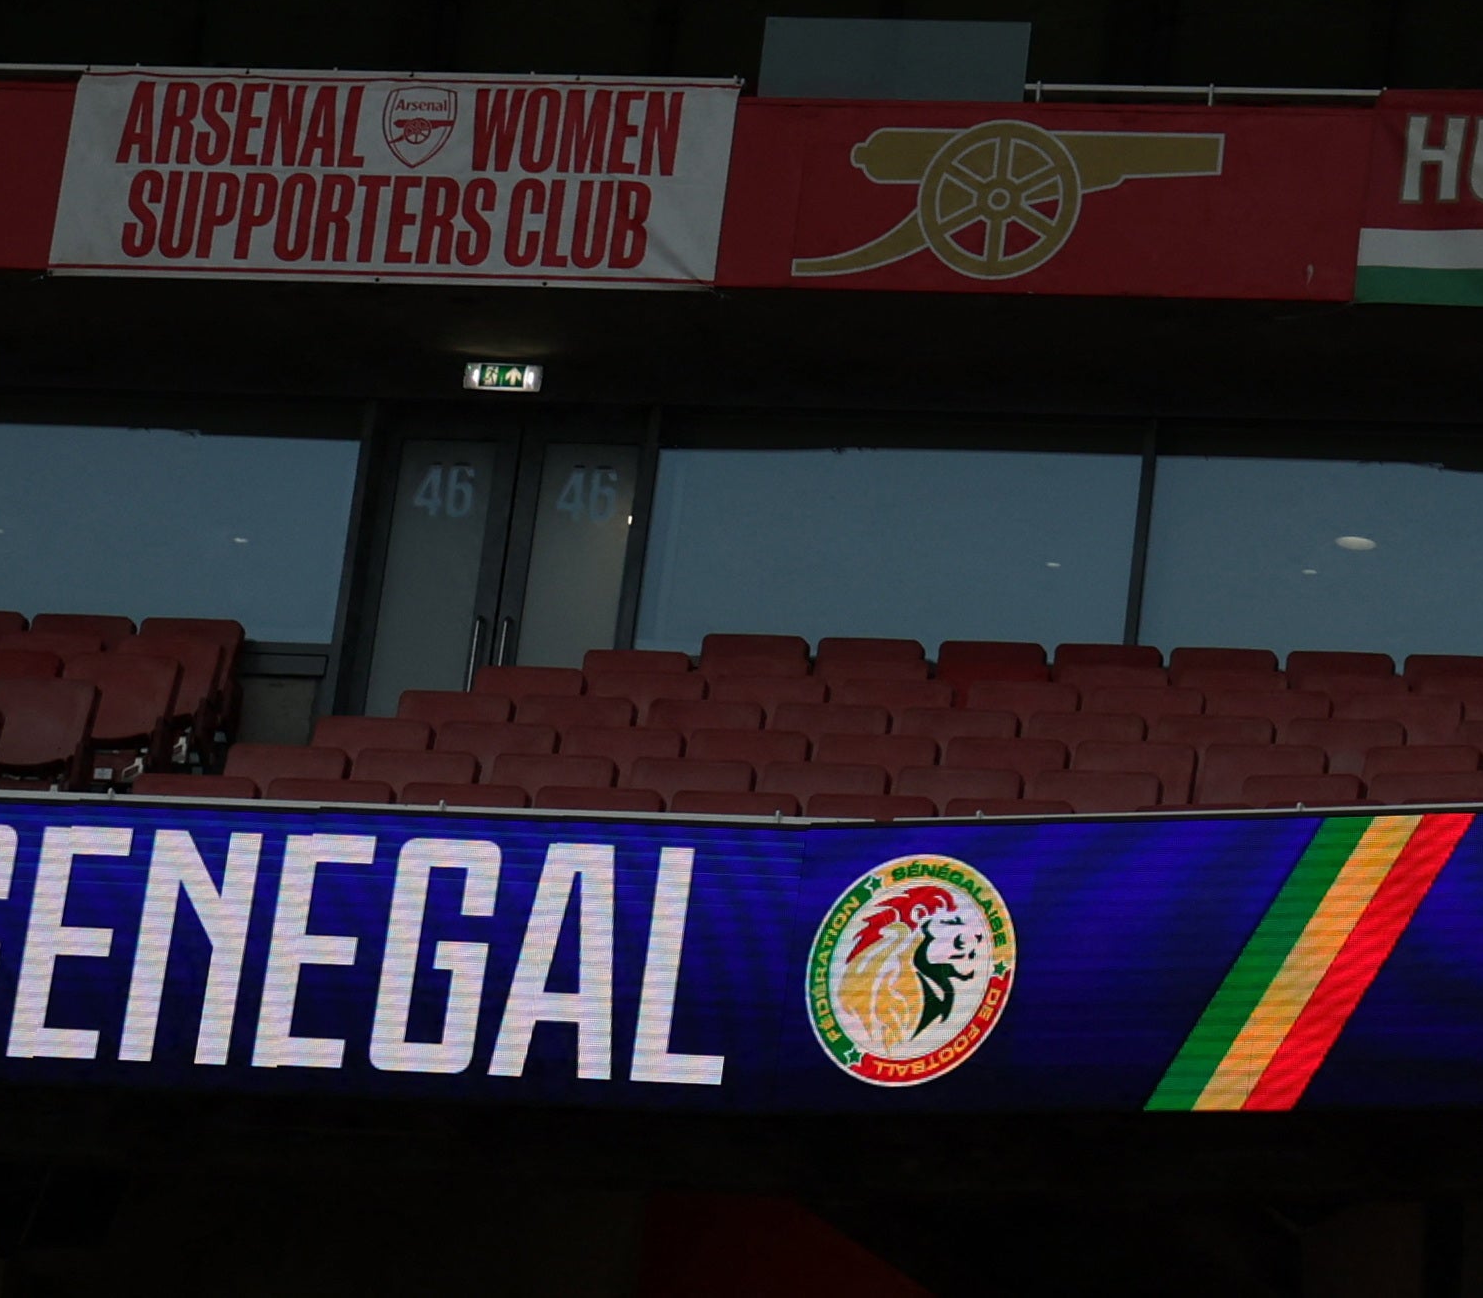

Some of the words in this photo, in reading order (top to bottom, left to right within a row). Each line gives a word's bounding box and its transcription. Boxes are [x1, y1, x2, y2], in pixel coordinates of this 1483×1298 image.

[116, 81, 365, 168] ARSENAL
[471, 87, 686, 176] WOMEN
[395, 98, 449, 113] Arsenal
[120, 171, 498, 264] SUPPORTERS
[504, 178, 651, 269] CLUB
[415, 462, 475, 518] 46
[558, 465, 617, 523] 46
[979, 988, 1001, 1020] DE
[873, 1025, 981, 1077] FOOTBALL
